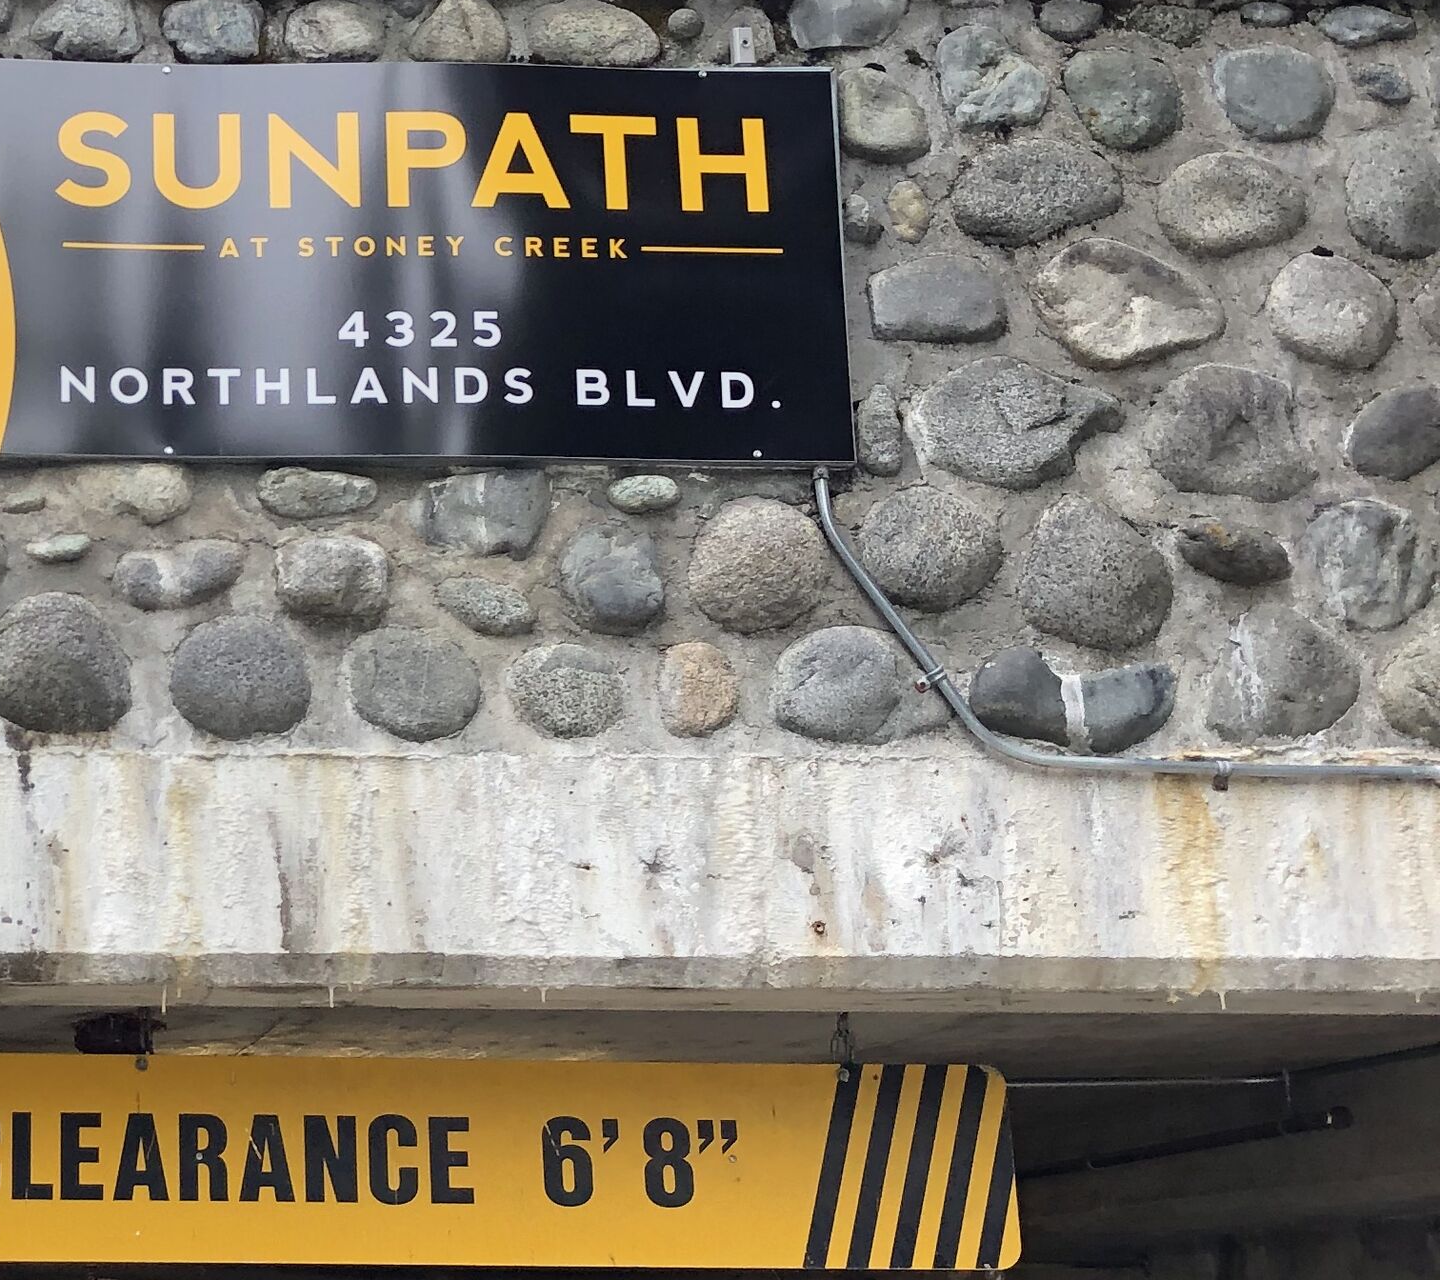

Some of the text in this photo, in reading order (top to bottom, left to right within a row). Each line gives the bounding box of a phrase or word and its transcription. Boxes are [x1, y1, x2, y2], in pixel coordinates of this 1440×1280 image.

[57, 112, 771, 214] SUNPATH
[219, 235, 628, 258] AT STONEY CREEK
[338, 310, 503, 349] 4325
[59, 365, 782, 409] NORTHLANDS BLVD.
